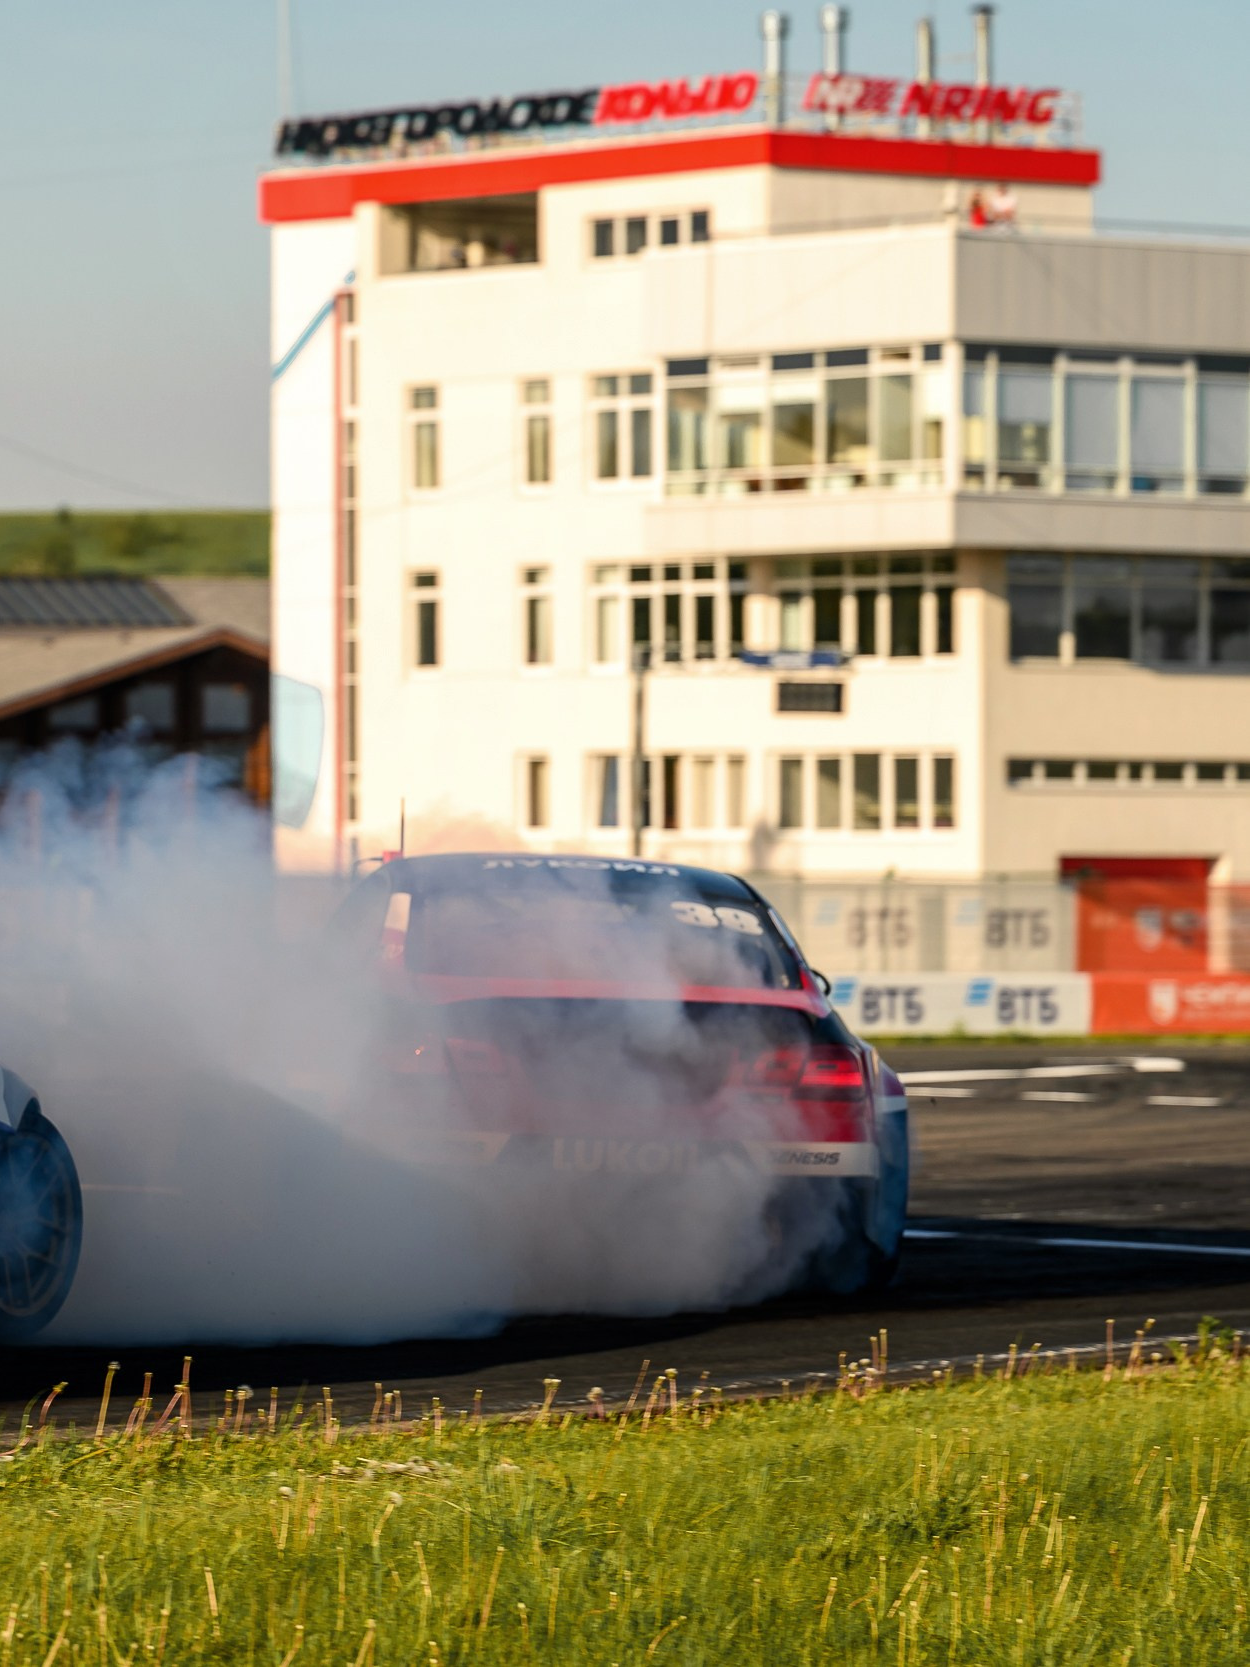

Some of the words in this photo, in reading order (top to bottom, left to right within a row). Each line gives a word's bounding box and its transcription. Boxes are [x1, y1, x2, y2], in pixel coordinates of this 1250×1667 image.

[670, 901, 764, 935] 38
[985, 907, 1050, 948] ВТБ
[861, 985, 925, 1024] ВТБ
[996, 986, 1059, 1024] ВТБ
